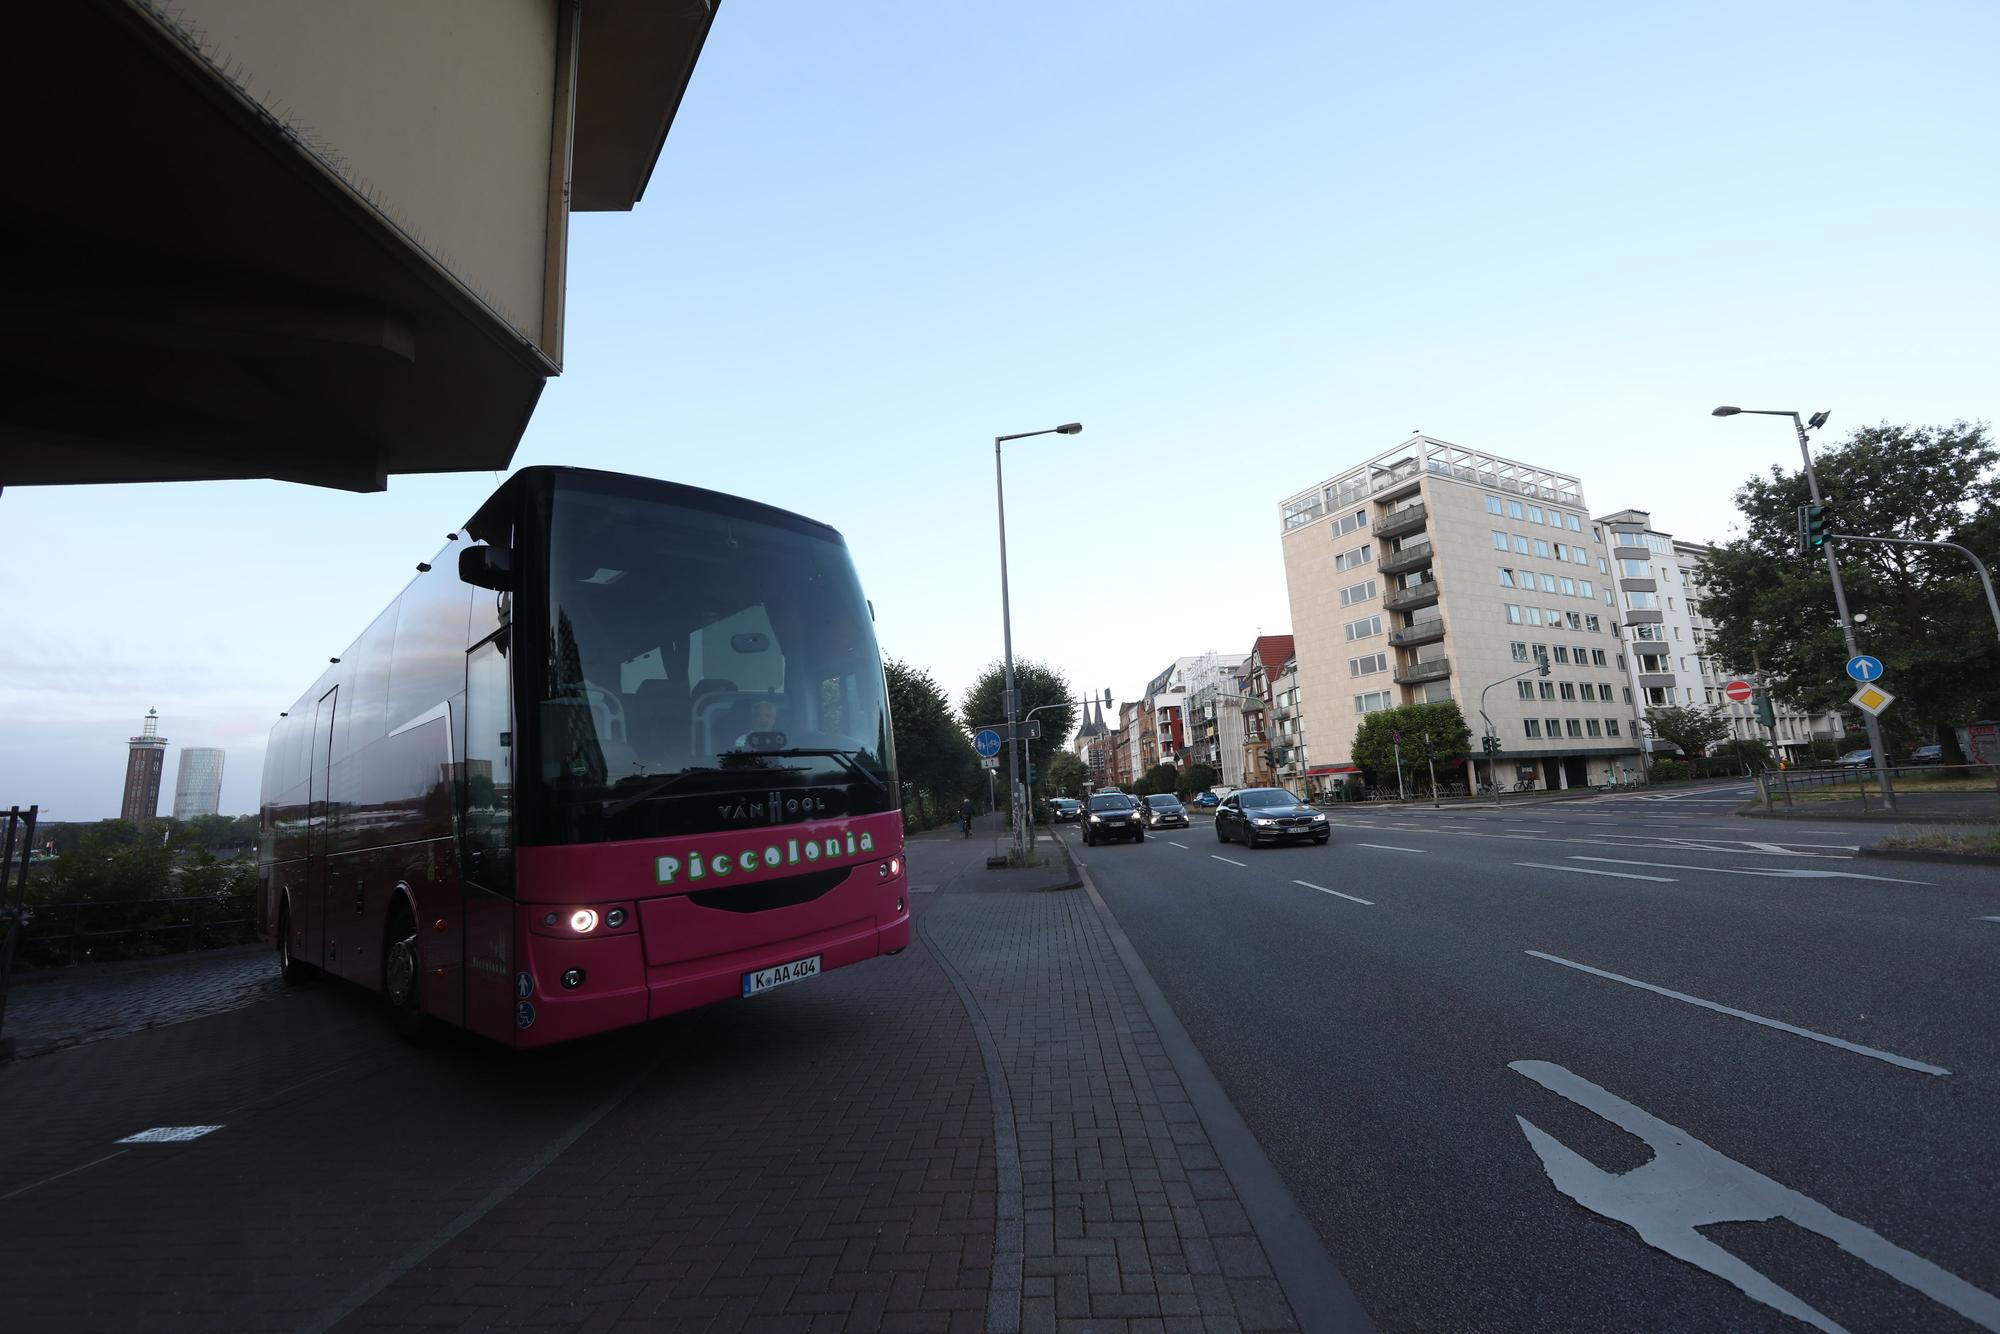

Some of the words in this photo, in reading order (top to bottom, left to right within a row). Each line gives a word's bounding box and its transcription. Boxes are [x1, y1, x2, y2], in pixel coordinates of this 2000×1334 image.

[717, 803, 764, 820] VAN
[768, 791, 825, 823] HOOL
[656, 831, 874, 884] Piccolonia
[755, 972, 766, 989] K
[773, 966, 791, 984] AA
[793, 959, 816, 977] 404
